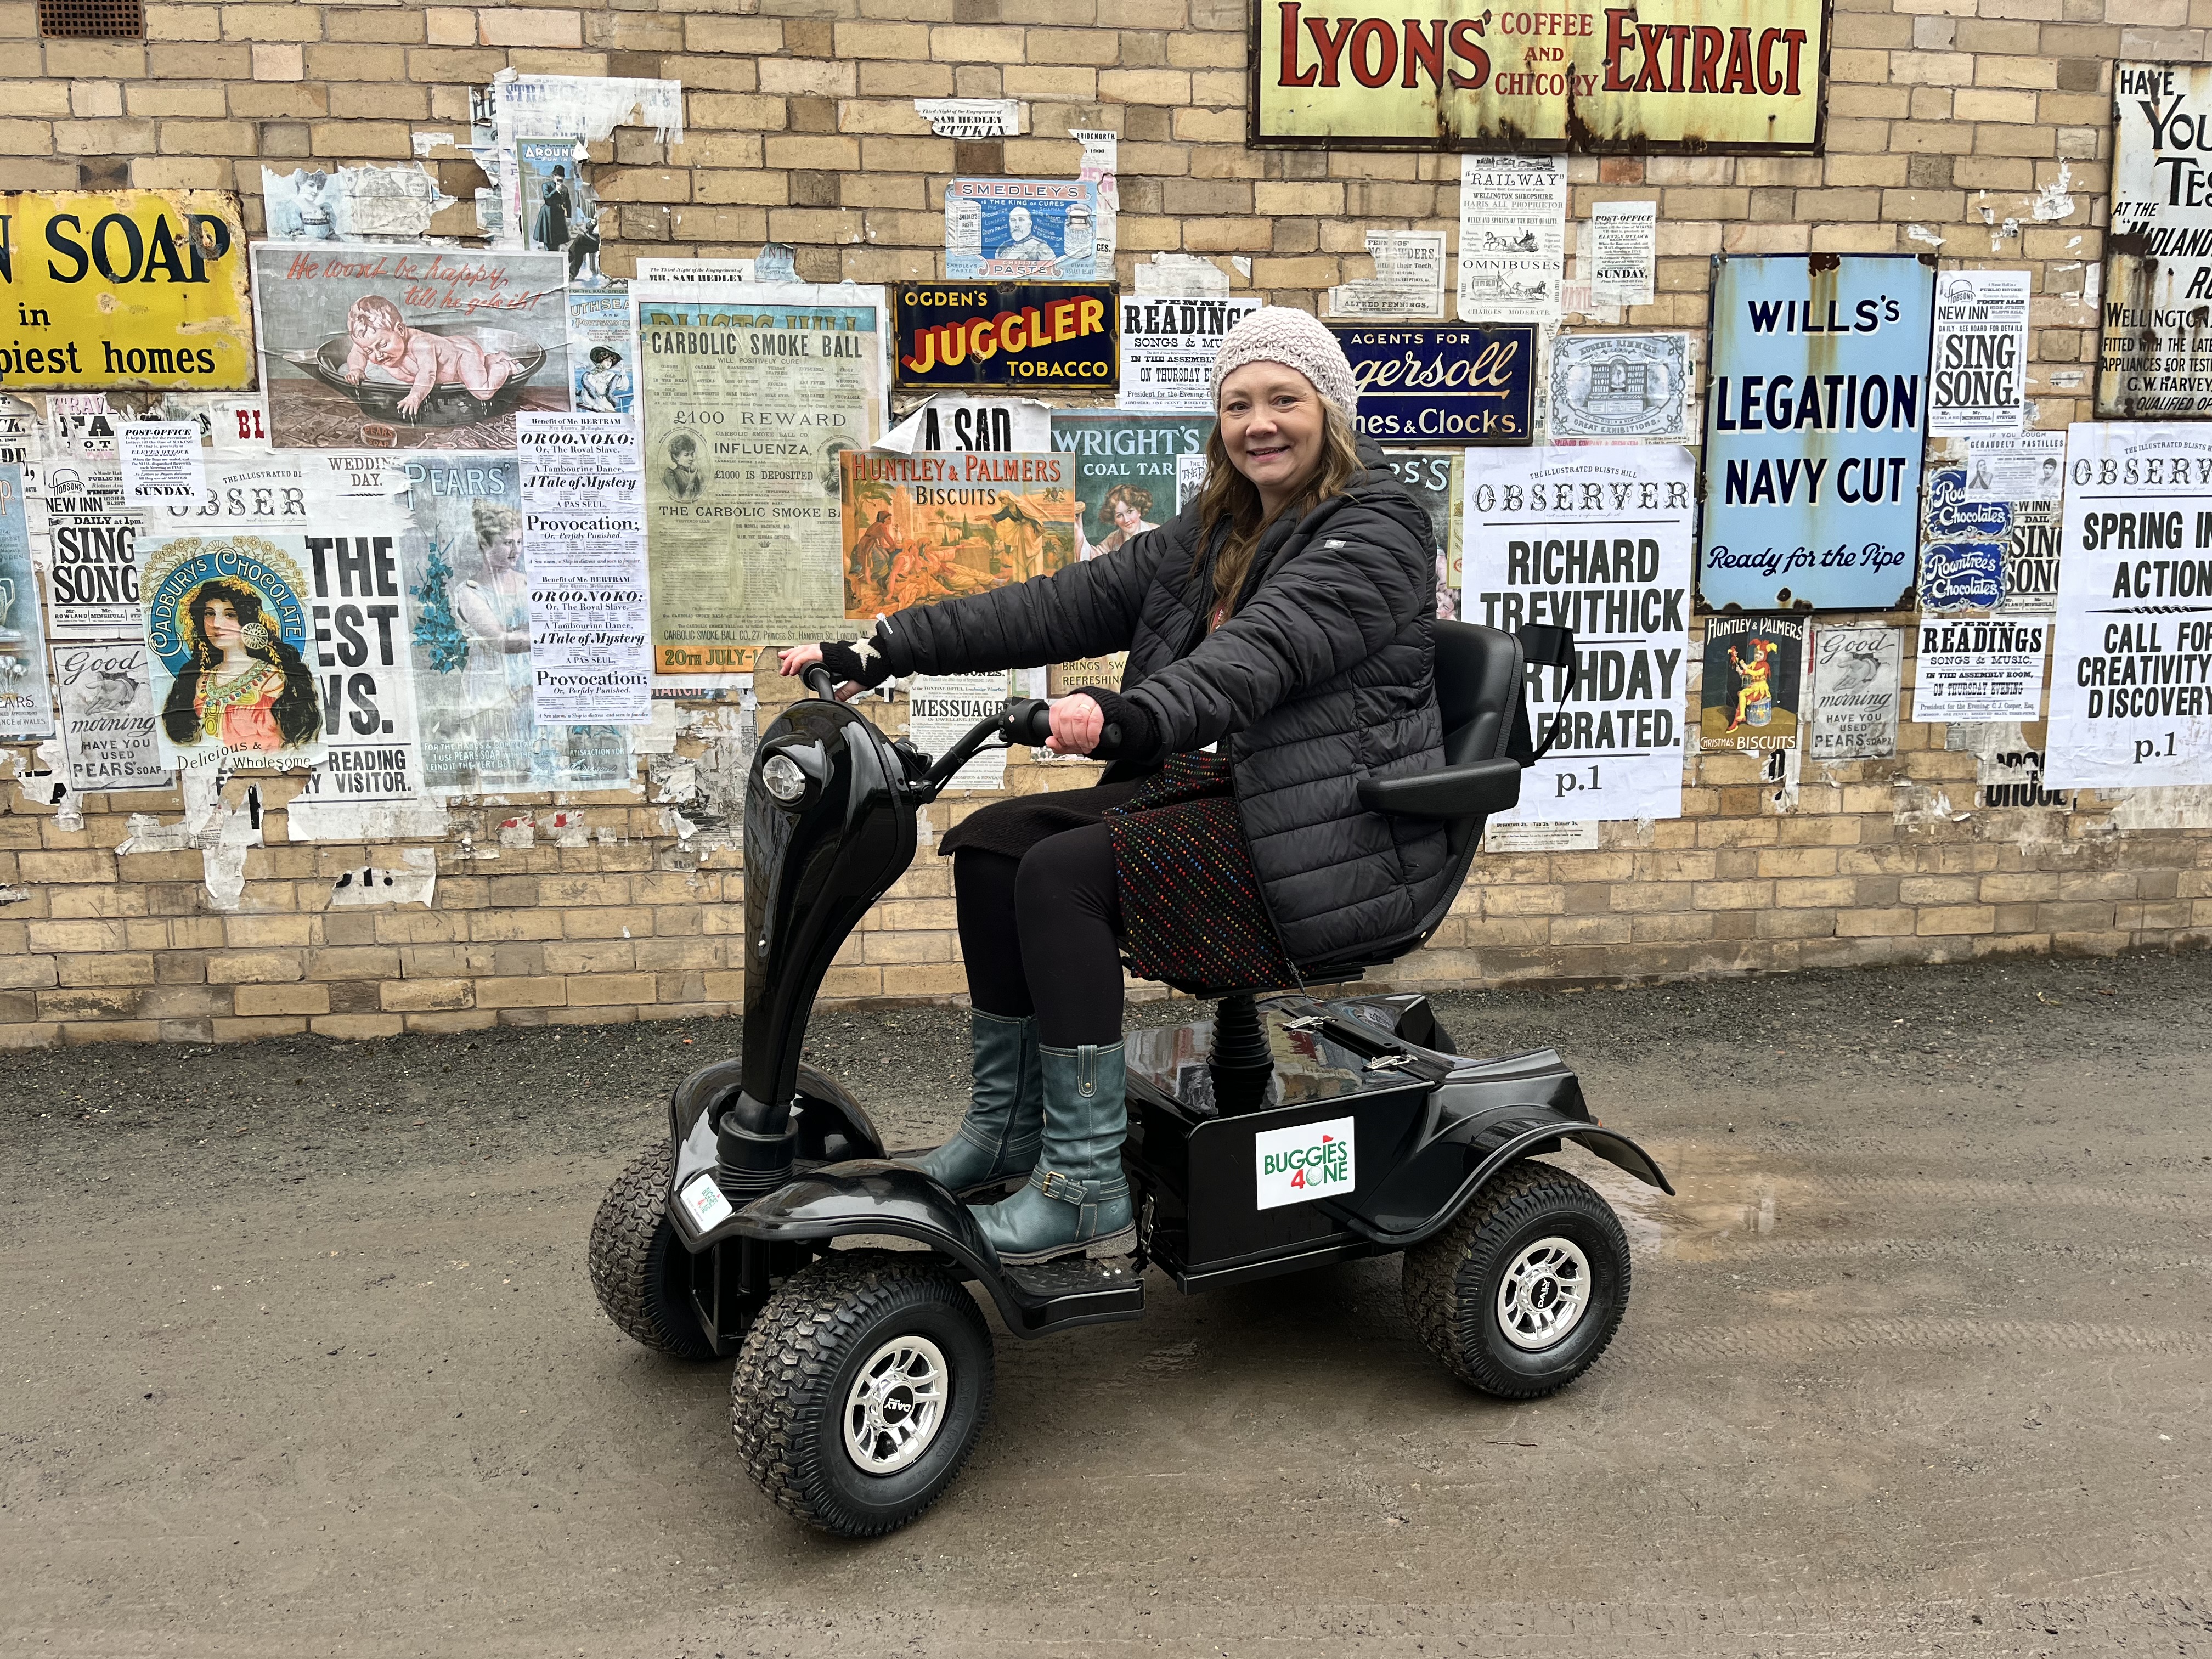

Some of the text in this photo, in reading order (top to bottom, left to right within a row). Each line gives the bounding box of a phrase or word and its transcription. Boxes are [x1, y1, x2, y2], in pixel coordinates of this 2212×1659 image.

[1501, 12, 1593, 36] COFFEE
[1278, 2, 1806, 95] LYONS' EXTRACT
[1523, 47, 1564, 61] AND
[1495, 72, 1599, 97] CHICORY
[963, 185, 1078, 197] SMEDLEY'S
[45, 213, 230, 284] SOAP
[287, 252, 318, 280] He
[394, 256, 419, 280] be
[423, 255, 508, 291] happy
[994, 266, 1047, 274] PASTE
[1463, 260, 1560, 270] OMNIBUSES
[1596, 269, 1647, 279] SUNDAY,
[439, 290, 462, 308] he
[905, 290, 988, 307] OGDEN'S
[19, 302, 50, 326] in
[1938, 306, 1988, 320] NEW INN
[652, 331, 862, 358] CARBOLIC SMOKE BALL
[901, 295, 1106, 375] JUGGLER
[1135, 338, 1178, 347] SONGS
[1351, 332, 1470, 345] AGENTS FOR
[2103, 337, 2186, 352] FITTED THE
[104, 341, 216, 374] homes
[1945, 334, 2016, 369] SING
[1006, 360, 1108, 377] TOBACCO
[1141, 368, 1200, 382] ON THURSDAY
[1352, 340, 1519, 396] gersoll
[2102, 358, 2162, 372] APPLIANCES
[1935, 370, 2020, 407] SONG.
[1716, 375, 1919, 434] LEGATION
[2137, 397, 2194, 410] QUALIFIED
[674, 410, 847, 427] £100 REWARD
[1419, 408, 1523, 435] Clocks.
[1573, 419, 1599, 431] GREAT
[926, 408, 1011, 451] A SAD
[714, 442, 812, 456] INFLUENZA,
[1051, 425, 1200, 456] WRIGHT'S
[2022, 439, 2063, 448] PASTILLES
[2138, 441, 2182, 452] ILLUSTRATED
[239, 470, 292, 482] ILLUSTRATED
[714, 470, 814, 480] £1000 DEPOSITED
[852, 454, 1061, 482] HUNTLEY PALMERS
[1084, 462, 1175, 476] COAL TAR
[1529, 466, 1638, 480] THE ILLUSTRATED BLISTS HILL
[350, 473, 383, 487] DAY.
[404, 462, 511, 512] PEARS'
[582, 476, 636, 490] Mystery
[1725, 458, 1827, 507] NAVY
[1837, 457, 1907, 506] CUT
[135, 486, 194, 496] SUNDAY,
[916, 486, 996, 506] BISCUITS
[1474, 481, 1690, 513] OBSERVER
[46, 497, 103, 512] NEW INN
[659, 506, 821, 518] THE CARBOLIC SMOKE
[74, 517, 112, 525] DAILY
[526, 515, 639, 533] Provocation;
[1939, 505, 2005, 526] Chocolates
[2083, 511, 2183, 550] SPRING
[57, 526, 135, 565] SING
[305, 537, 399, 597] THE
[1507, 538, 1660, 586] RICHARD
[1707, 543, 1905, 576] Ready for the Pipe
[1927, 552, 1996, 581] Rowntree's
[215, 548, 303, 639] CHOCOLATE
[1932, 577, 1997, 599] Chocolates
[1480, 589, 1685, 635] TREVITHICK
[664, 630, 719, 640] CARBOLIC SMOKE
[1706, 618, 1803, 646] HUNTLEY PALMERS
[1922, 627, 2042, 654] READINGS
[2104, 623, 2162, 654] CALL
[1819, 633, 1895, 664] Good
[58, 650, 151, 686] Good
[1062, 661, 1101, 670] BRINGS
[1930, 656, 2032, 665] SONGS MUSIC.
[2077, 654, 2212, 688] CREATIVITY
[1523, 648, 1682, 703] RTHDAY
[1948, 682, 2023, 696] THURSDAY EVENING
[1818, 691, 1892, 713] morning
[70, 713, 156, 737] morning
[1826, 713, 1881, 723] HAVE YOU
[1839, 723, 1867, 732] USED
[83, 739, 150, 750] HAVE YOU
[1699, 736, 1796, 749] CHRISTMAS BISCUITS
[2134, 731, 2177, 765] p.1
[101, 751, 134, 759] USED
[177, 741, 249, 770] Delicious
[233, 754, 311, 769] Wholesome
[329, 750, 405, 772] READING
[73, 762, 137, 777] PEARS'
[335, 771, 412, 793] VISITOR.
[1555, 764, 1602, 798] p.1
[1265, 1141, 1347, 1175] BUGGIES
